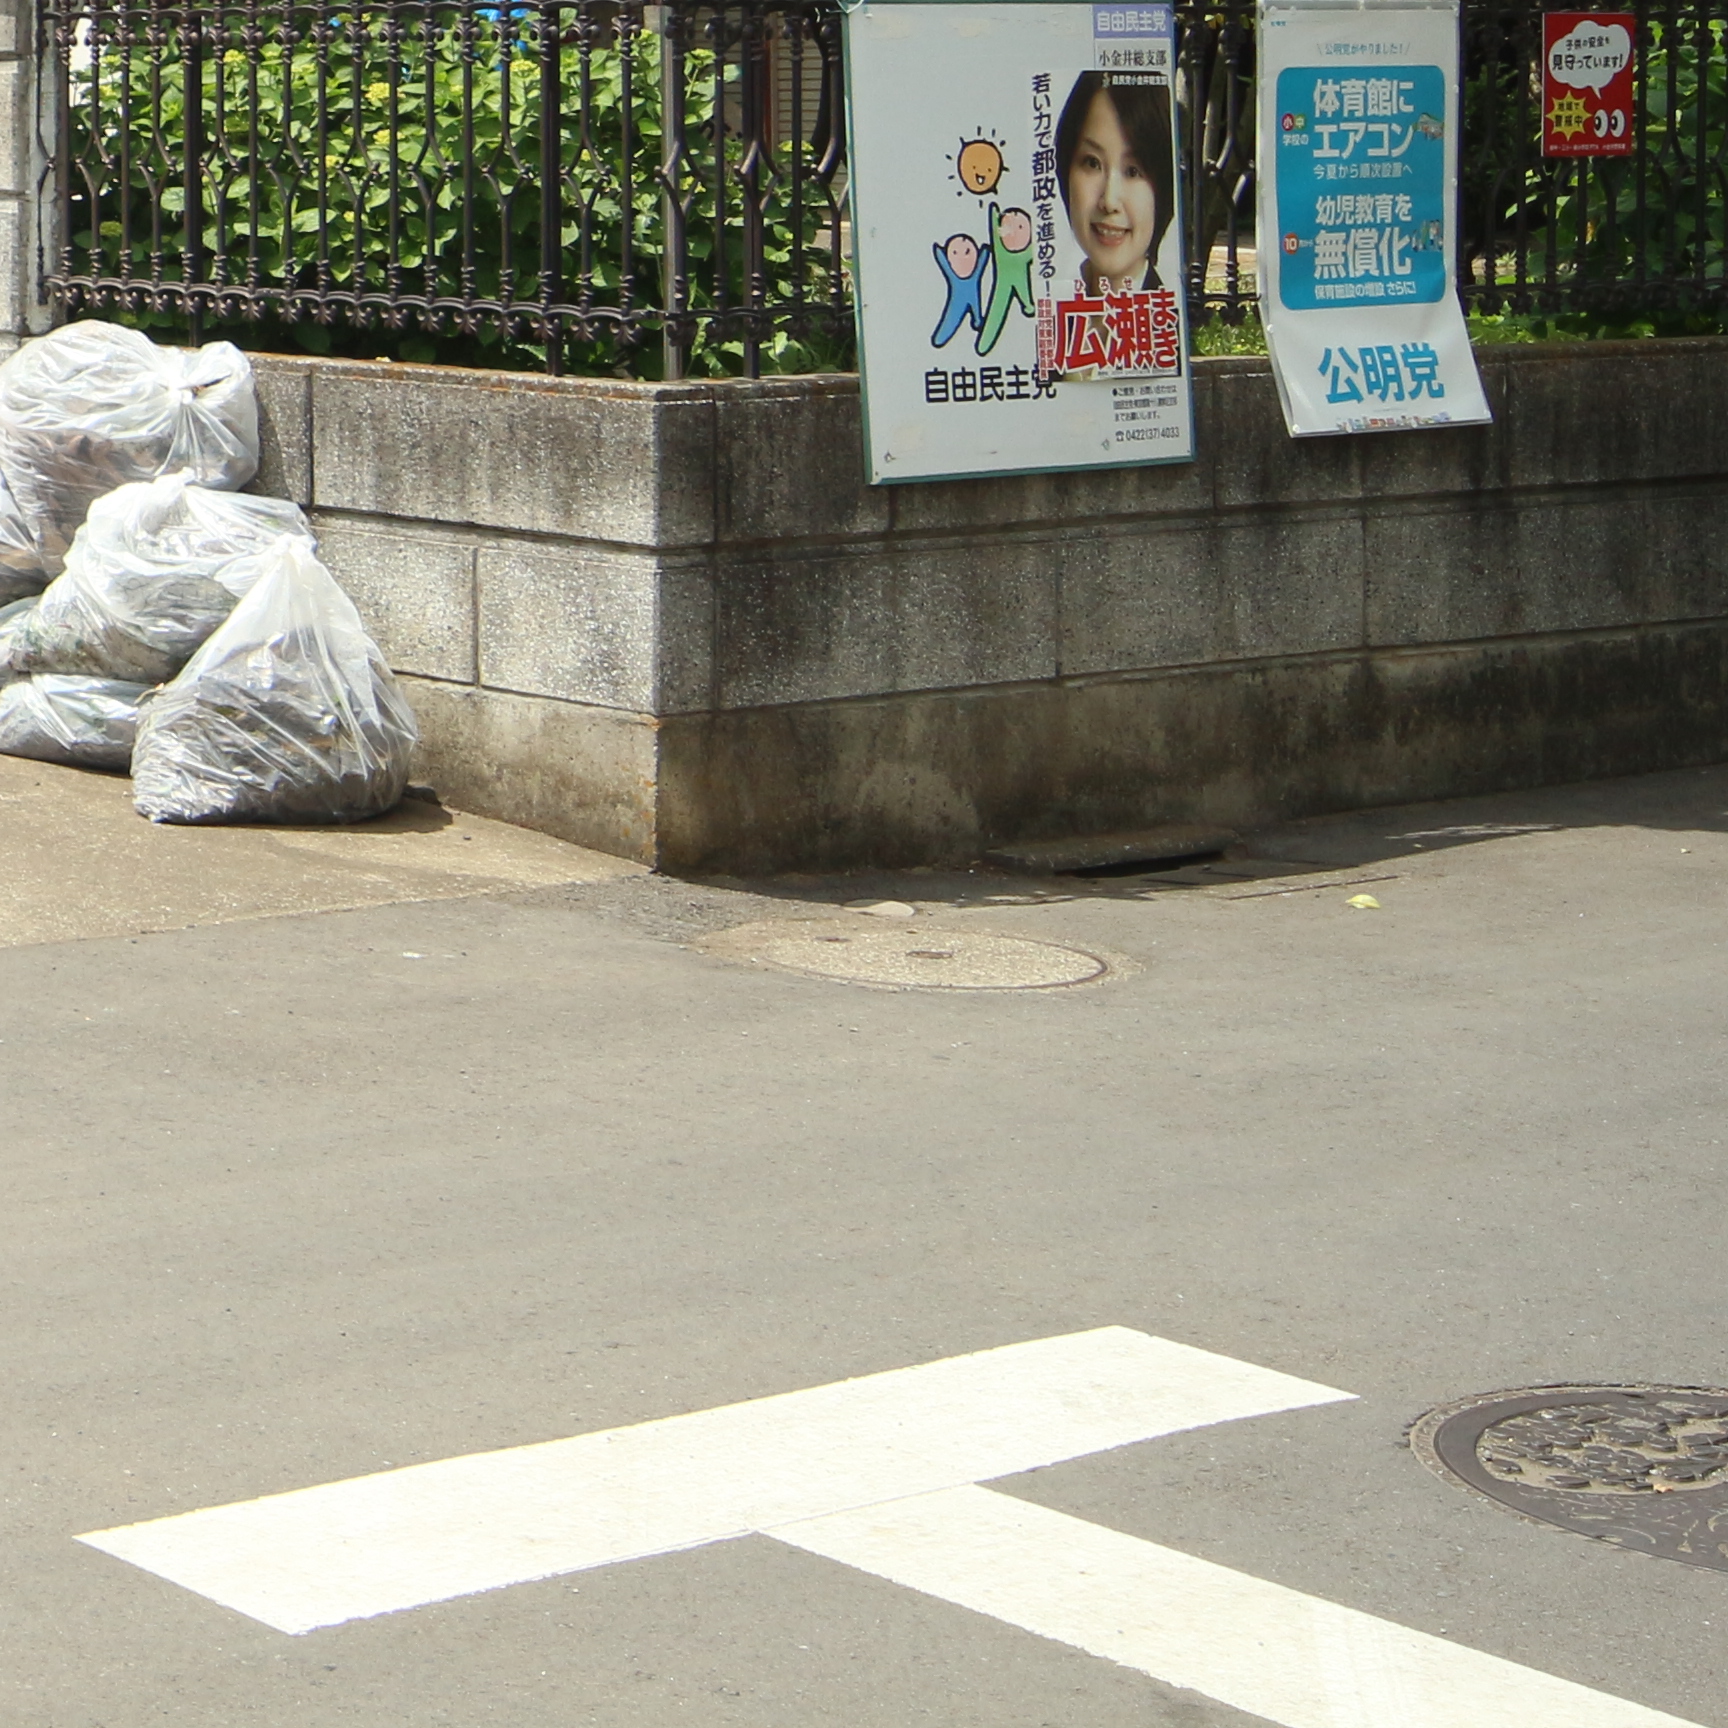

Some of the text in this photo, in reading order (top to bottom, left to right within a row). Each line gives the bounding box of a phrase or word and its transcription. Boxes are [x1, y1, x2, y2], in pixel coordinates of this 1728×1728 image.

[1097, 10, 1166, 32] 自由民主党
[1099, 49, 1167, 67] 小金井総支部
[1552, 54, 1623, 71] 見守っています!
[1313, 78, 1415, 118] 体育館に
[1282, 134, 1309, 147] 学校の
[1313, 121, 1414, 160] エアコン
[1031, 72, 1056, 298] 若い力で都政を進める!
[1313, 161, 1413, 180] 今夏から順次設置へ
[1315, 192, 1413, 226] 幼児教育を
[1313, 227, 1413, 280] 無償化
[1073, 277, 1133, 292] ひろせ
[1053, 287, 1180, 372] 広瀬 まき
[925, 363, 1058, 403] 自由民主党
[1317, 342, 1445, 405] 公明党
